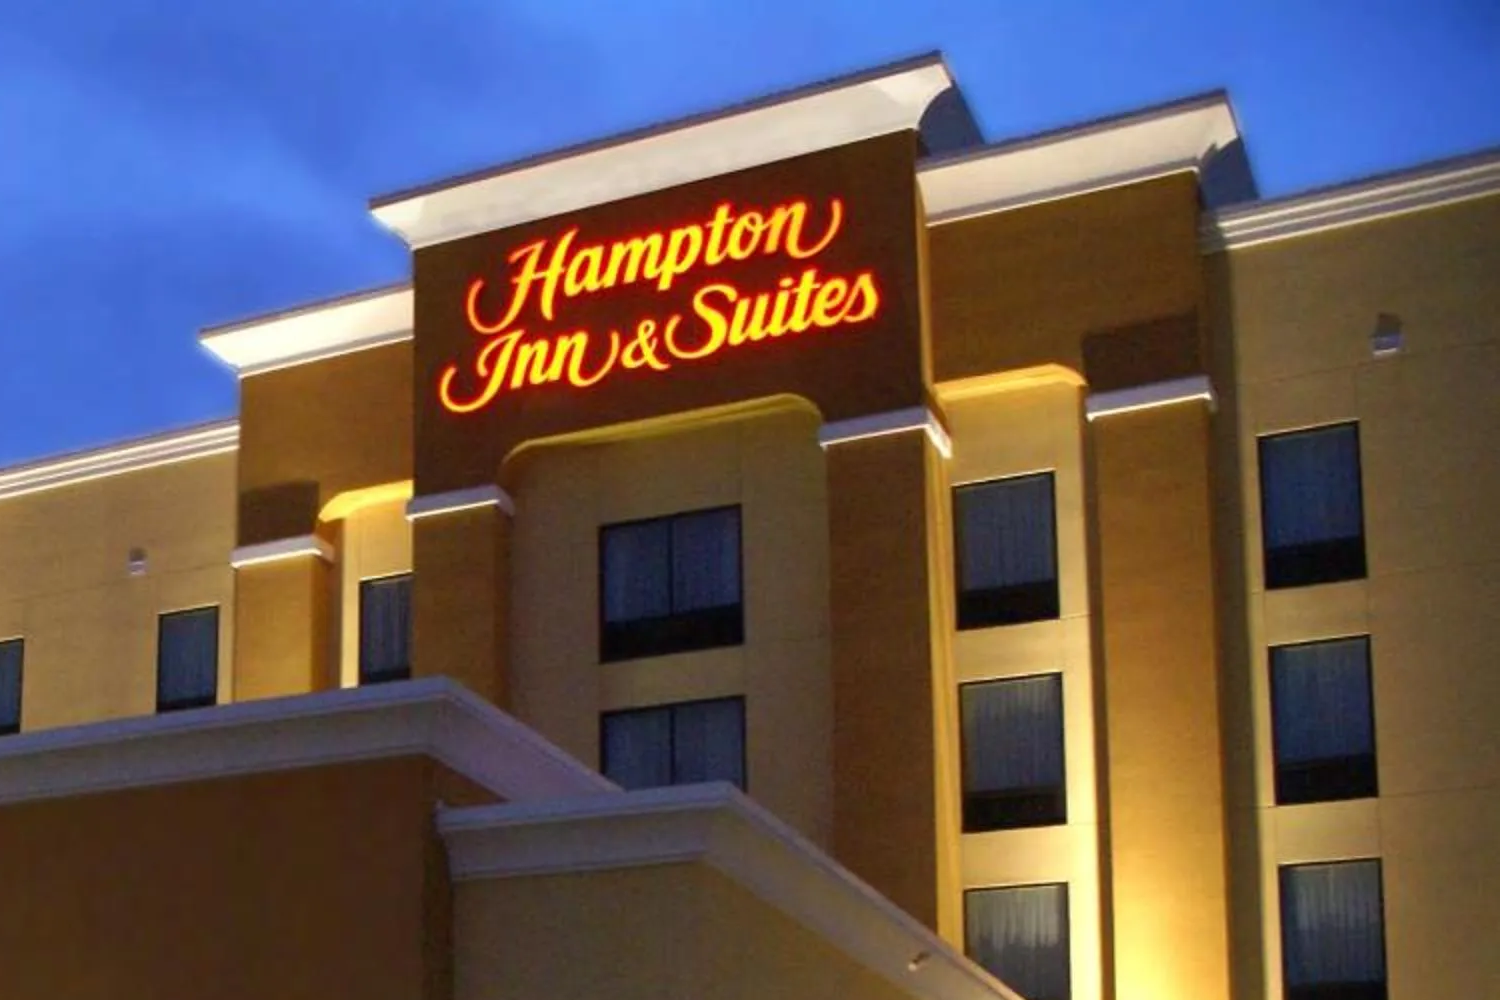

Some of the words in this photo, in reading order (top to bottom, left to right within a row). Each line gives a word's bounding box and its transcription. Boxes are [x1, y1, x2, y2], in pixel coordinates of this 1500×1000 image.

[466, 200, 842, 334] Hampton
[439, 329, 619, 413] Inn
[621, 320, 670, 370] &
[665, 270, 880, 359] Suites
